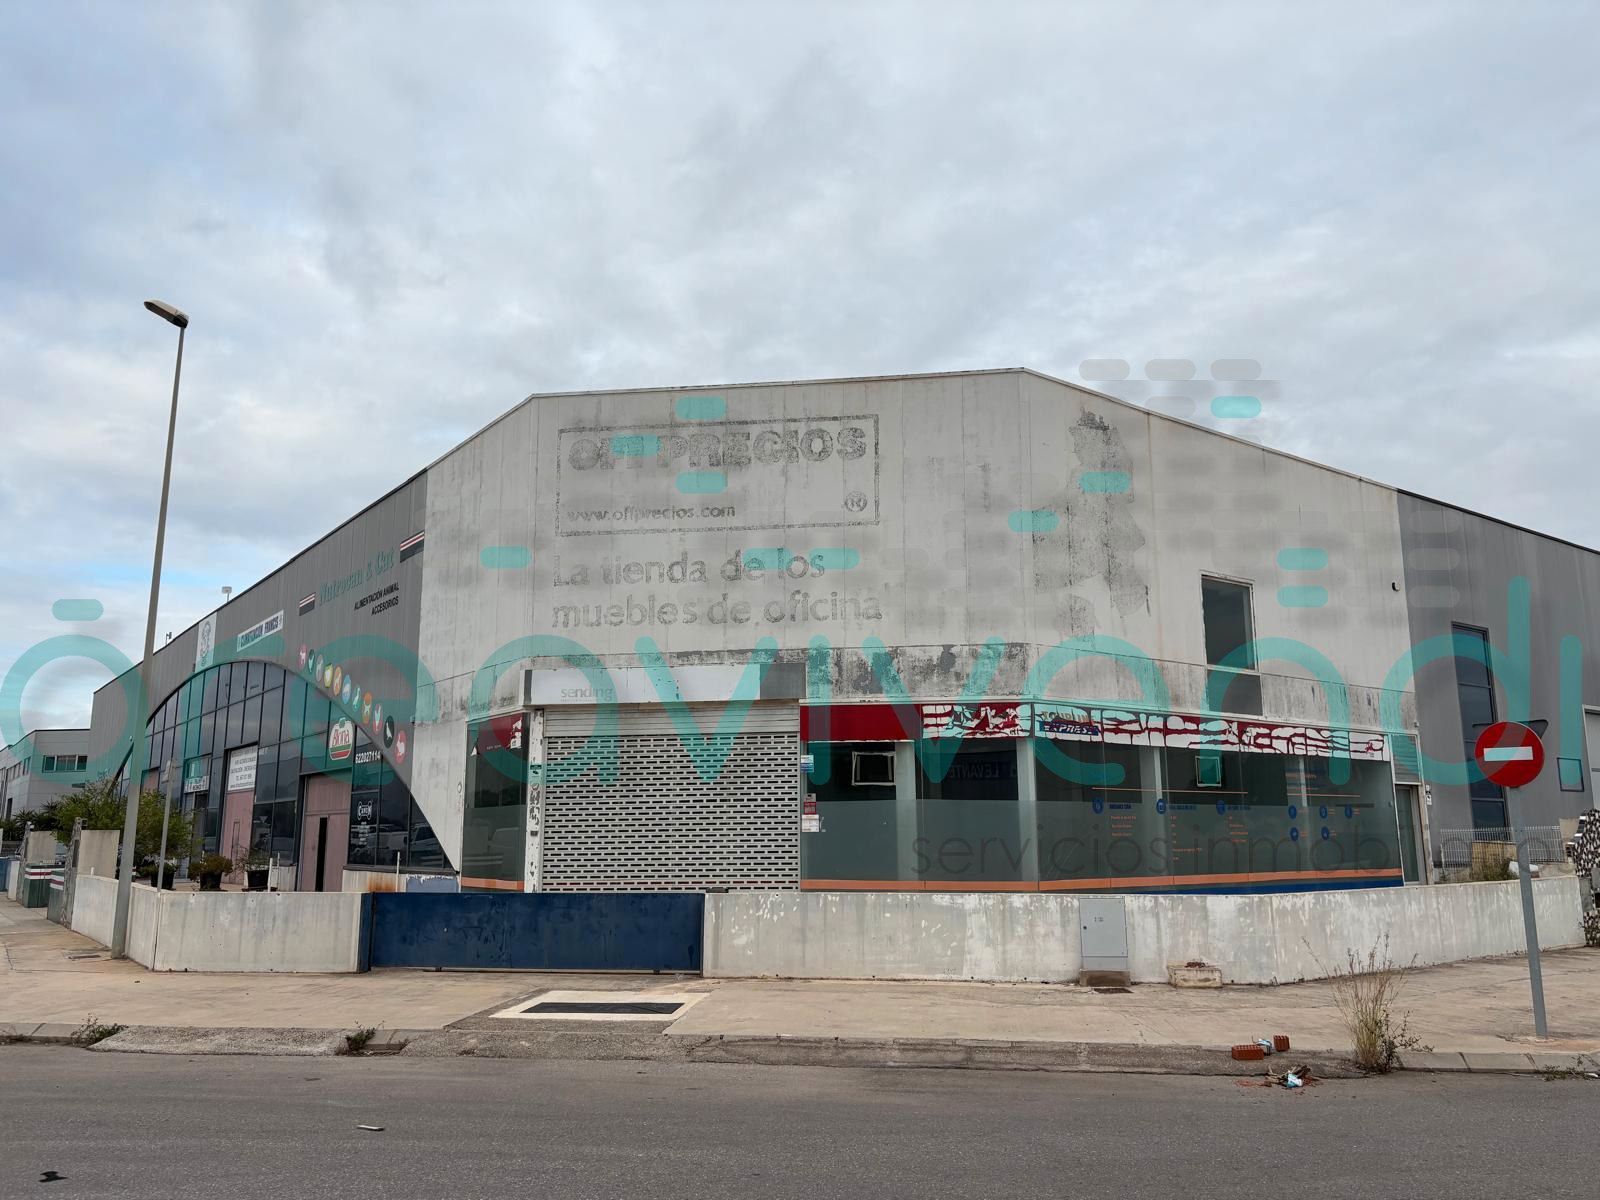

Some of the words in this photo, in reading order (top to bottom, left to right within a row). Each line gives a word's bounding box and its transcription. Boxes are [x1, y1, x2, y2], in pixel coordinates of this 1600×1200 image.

[553, 554, 591, 587] La
[600, 550, 709, 585] tienda
[719, 548, 766, 582] de
[776, 547, 826, 580] los
[551, 593, 699, 628] muebles
[706, 592, 751, 625] de
[762, 588, 884, 625] oficina
